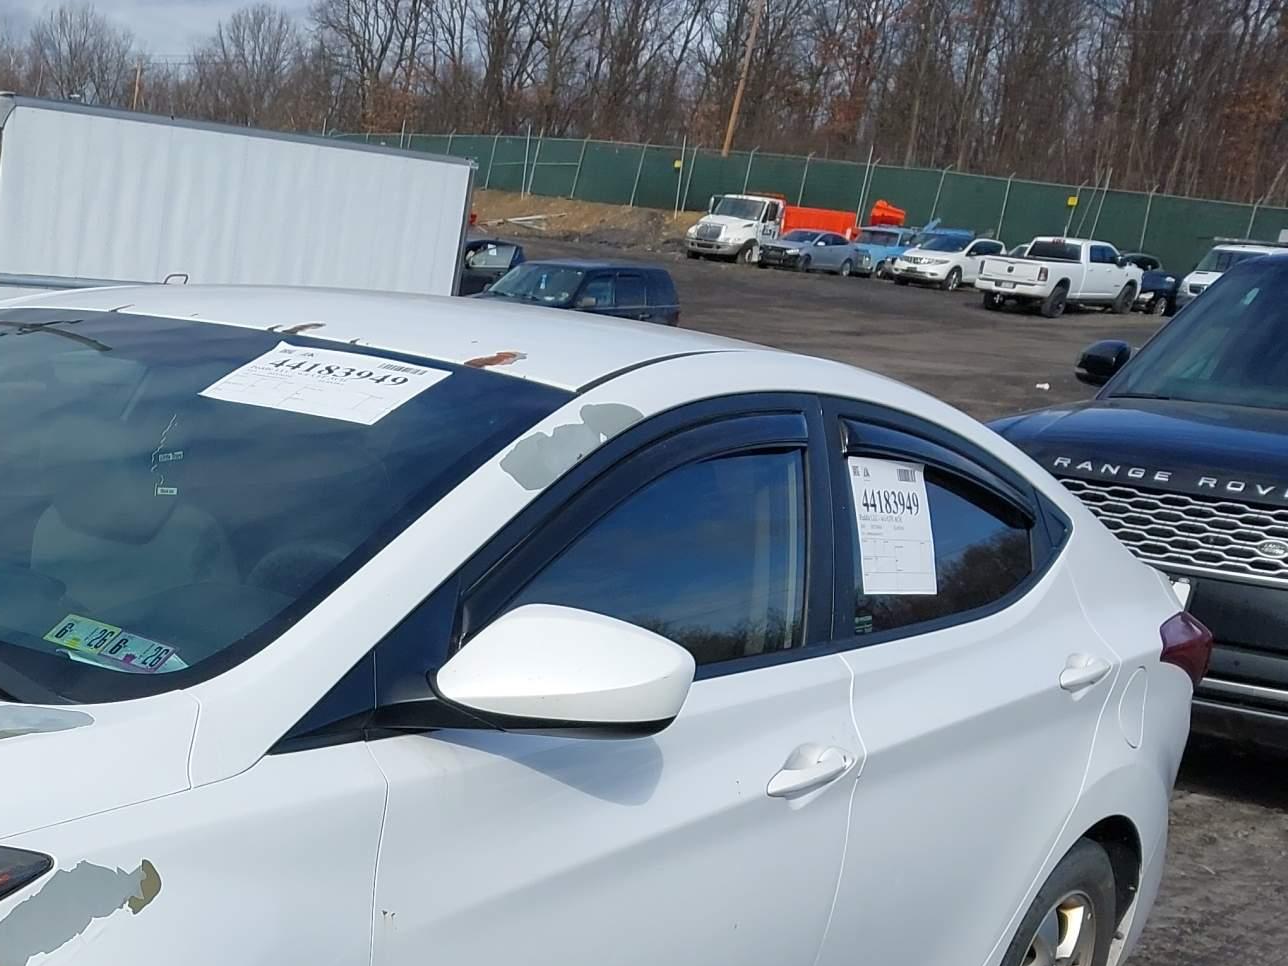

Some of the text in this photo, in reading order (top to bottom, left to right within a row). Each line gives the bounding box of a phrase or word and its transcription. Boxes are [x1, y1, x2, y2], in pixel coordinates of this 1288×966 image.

[268, 358, 410, 388] 44183949
[1053, 455, 1288, 502] RANGE ROV
[861, 487, 920, 517] 44183949
[55, 622, 114, 650] 6 26
[109, 638, 170, 668] 6 26
